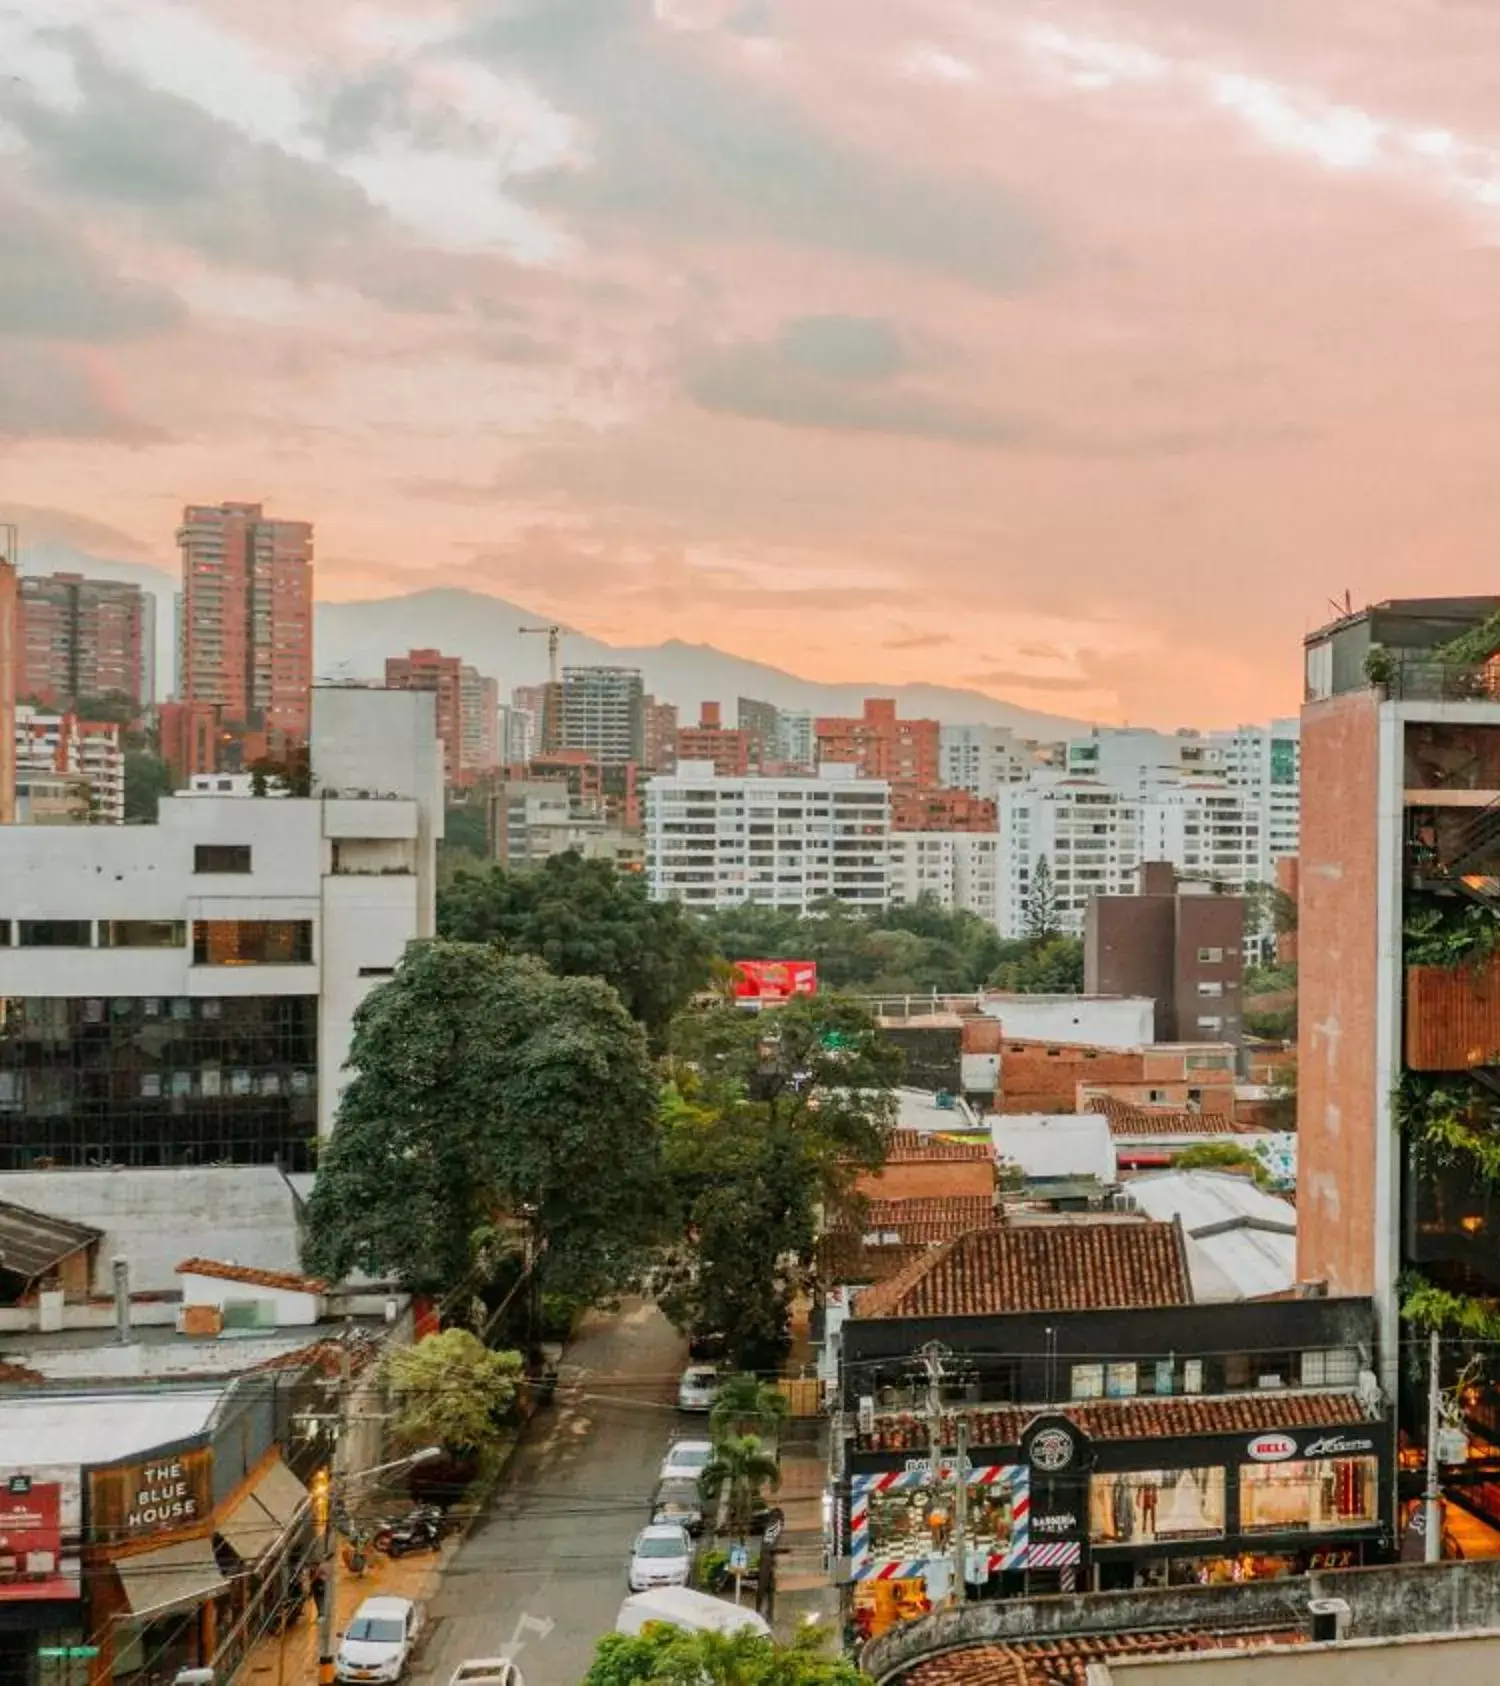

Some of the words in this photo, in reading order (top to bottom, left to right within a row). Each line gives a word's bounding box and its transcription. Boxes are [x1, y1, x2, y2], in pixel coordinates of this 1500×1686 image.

[1257, 1441, 1288, 1453] BELL
[144, 1464, 181, 1483] THE
[139, 1483, 186, 1505] BLUE
[130, 1500, 195, 1525] HOUSE
[1310, 1551, 1351, 1569] FOX
